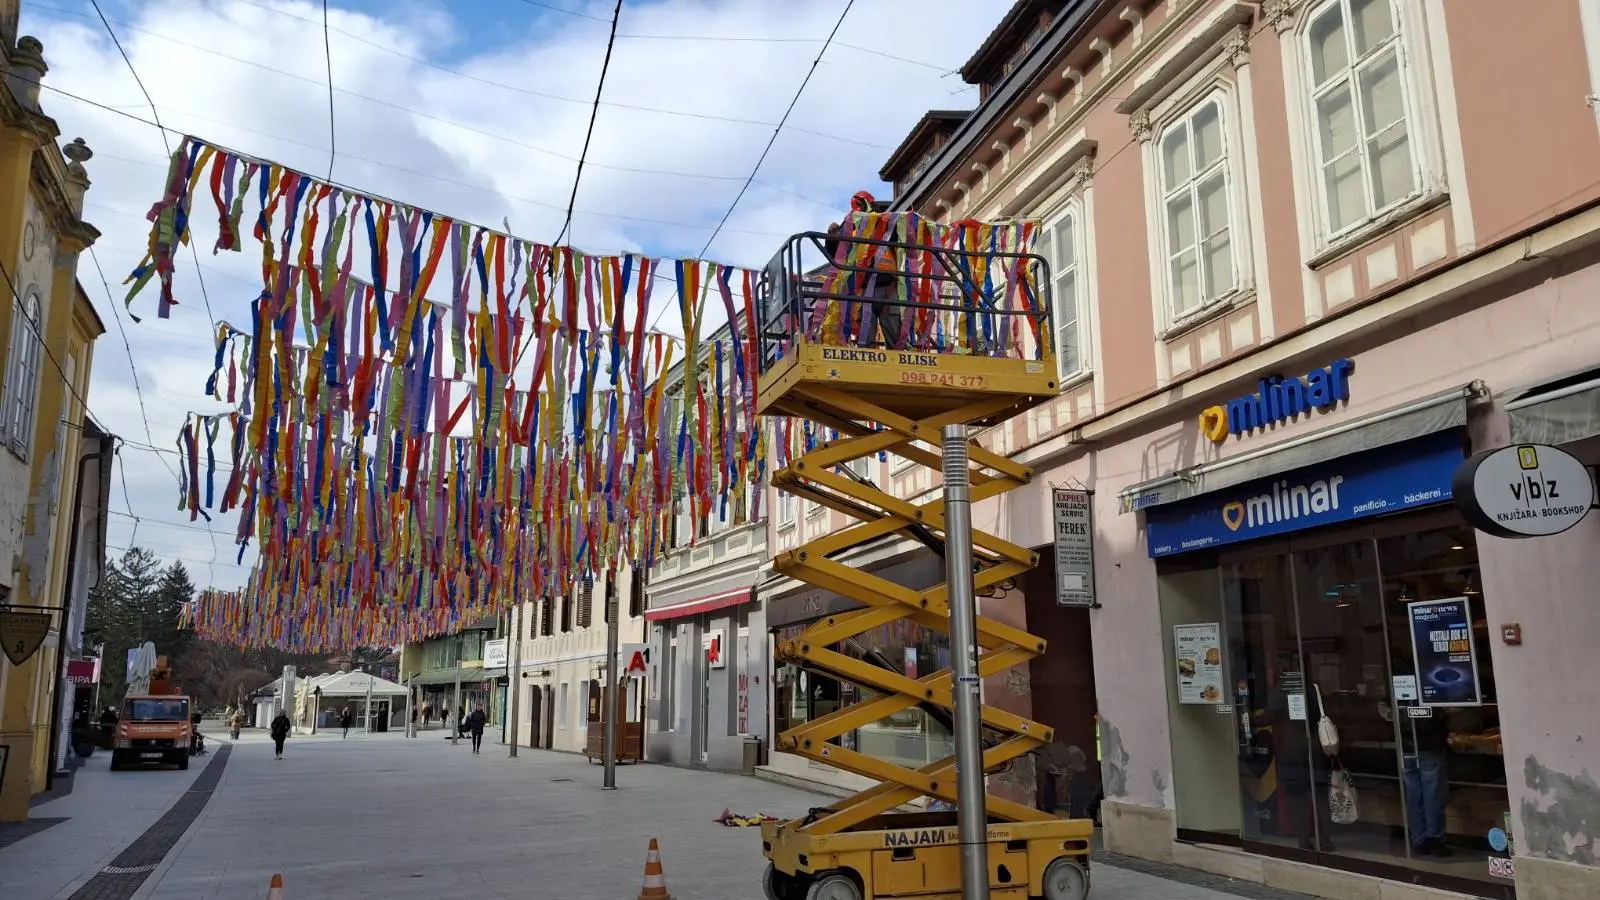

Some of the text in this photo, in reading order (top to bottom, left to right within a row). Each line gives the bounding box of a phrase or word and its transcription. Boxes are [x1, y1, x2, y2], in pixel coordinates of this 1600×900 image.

[822, 348, 938, 367] ELEKTRO BLISK
[901, 371, 926, 383] 098
[959, 375, 984, 387] 377
[1228, 358, 1352, 434] mlinar
[1057, 493, 1085, 503] EXPRES
[1246, 475, 1343, 528] mlinar
[1061, 510, 1084, 518] SERVIS
[1353, 499, 1387, 516] panificio
[1497, 505, 1585, 521] KNJIŽARA BOOKSHOP
[627, 648, 651, 672] A1
[68, 676, 90, 684] BIPA
[885, 830, 945, 847] NAJAM
